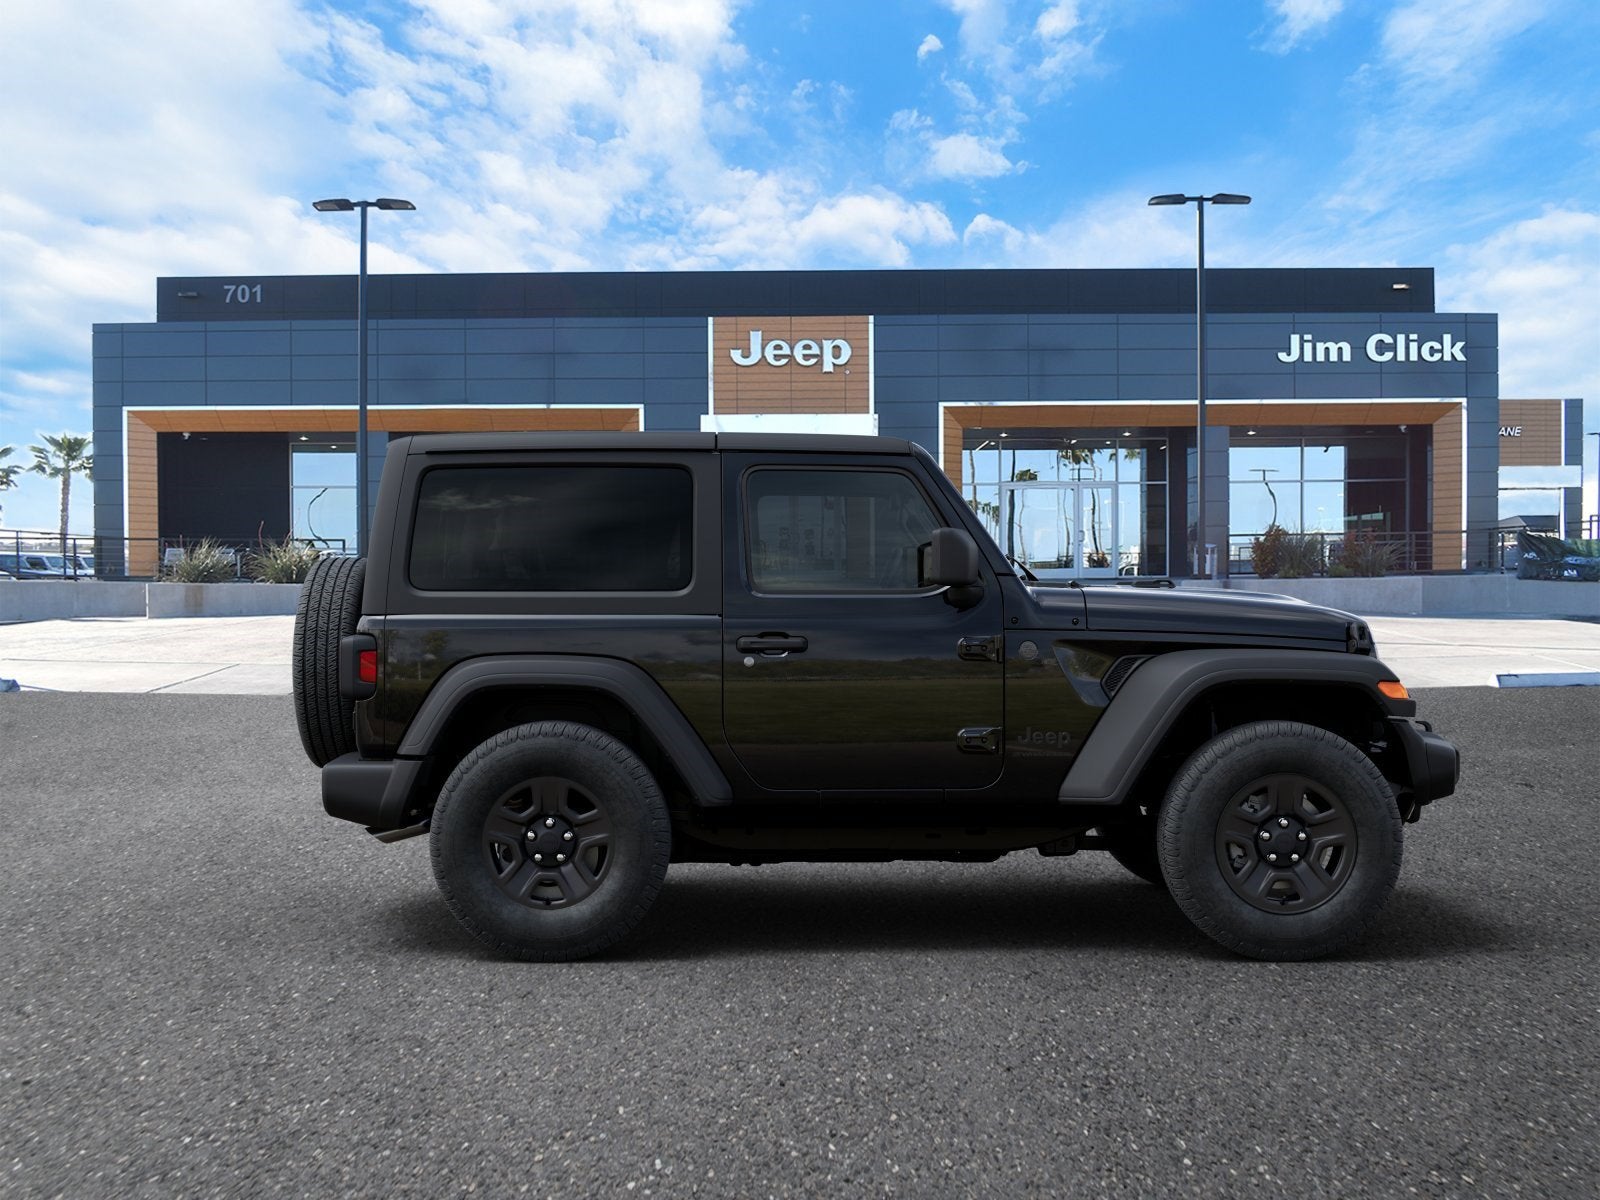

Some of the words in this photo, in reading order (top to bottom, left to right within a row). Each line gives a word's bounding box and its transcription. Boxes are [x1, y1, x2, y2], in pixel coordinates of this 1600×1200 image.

[223, 284, 262, 303] 701
[729, 330, 852, 373] Jeep
[1277, 333, 1351, 362] Jim
[1365, 333, 1467, 362] Click
[1017, 727, 1072, 748] Jeep
